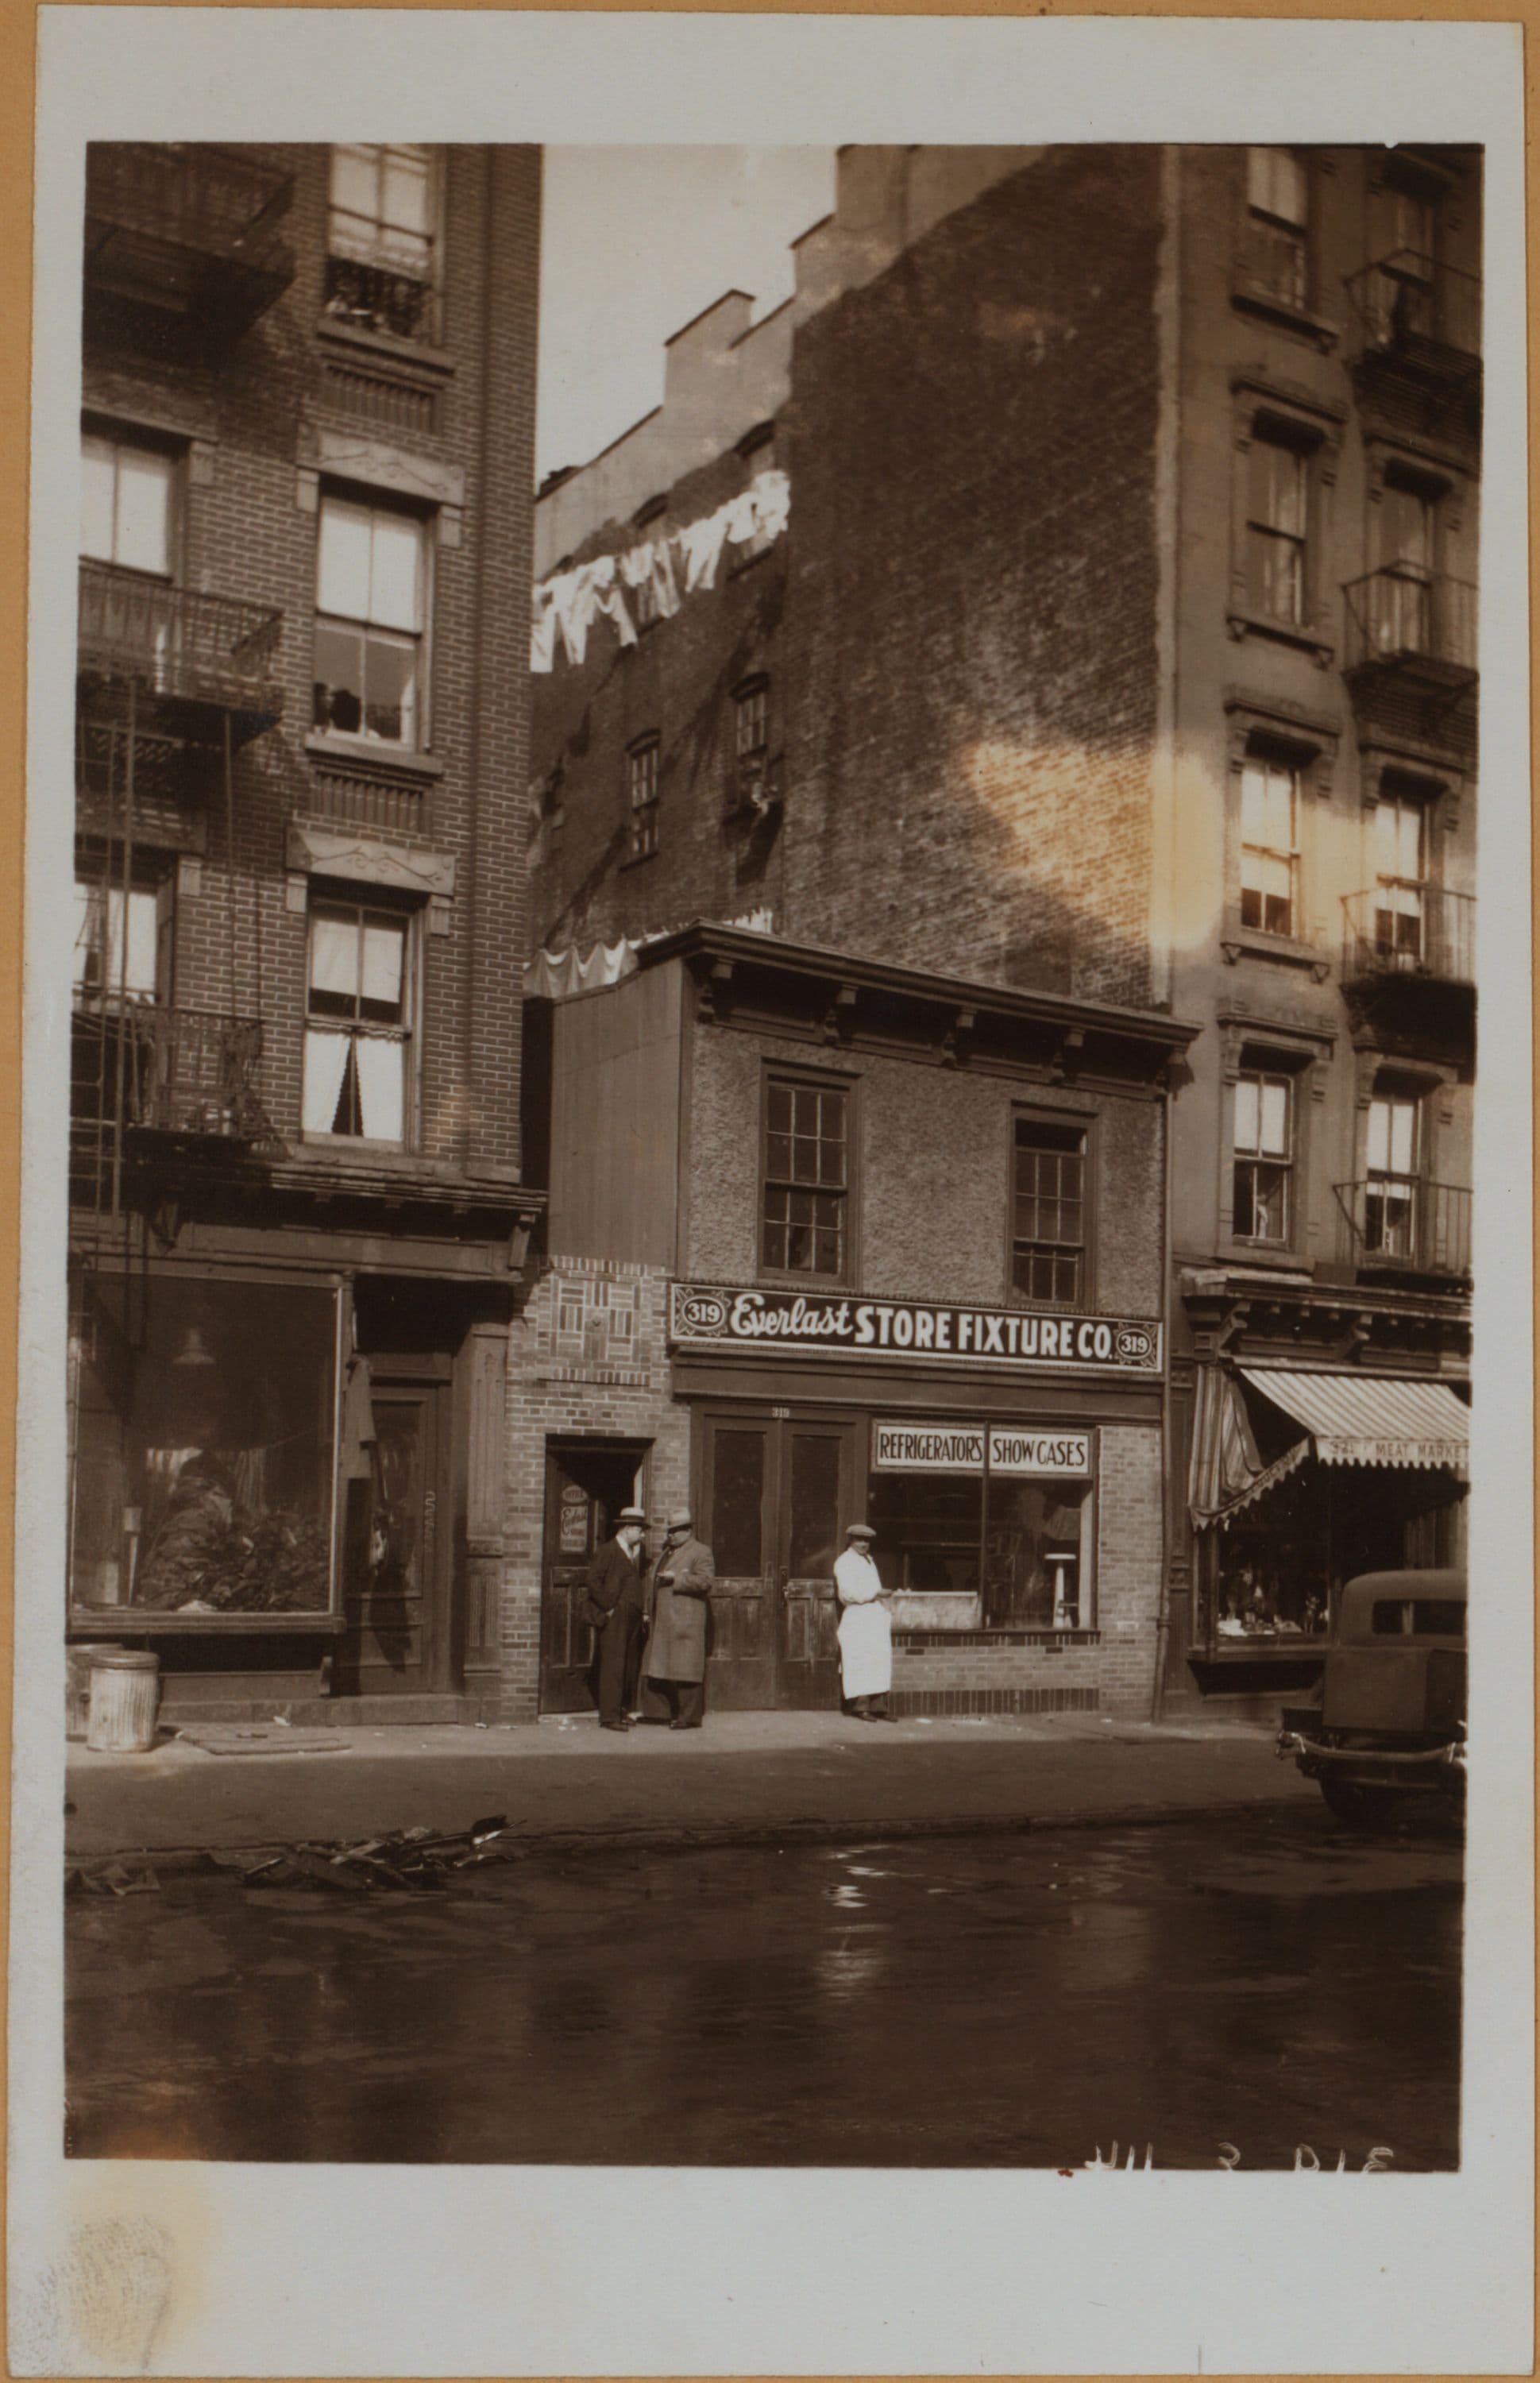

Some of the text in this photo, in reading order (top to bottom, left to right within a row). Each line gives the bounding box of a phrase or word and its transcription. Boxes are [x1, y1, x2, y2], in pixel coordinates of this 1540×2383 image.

[688, 1303, 720, 1323] 319
[731, 1293, 853, 1336] Everlast
[855, 1305, 951, 1349] STORE
[958, 1313, 1074, 1357] FIXTURE
[1121, 1334, 1148, 1354] 319
[879, 1433, 982, 1462] REFRIGERATORS
[993, 1438, 1085, 1466] SHOW CASES
[1376, 1443, 1409, 1456] MEAT
